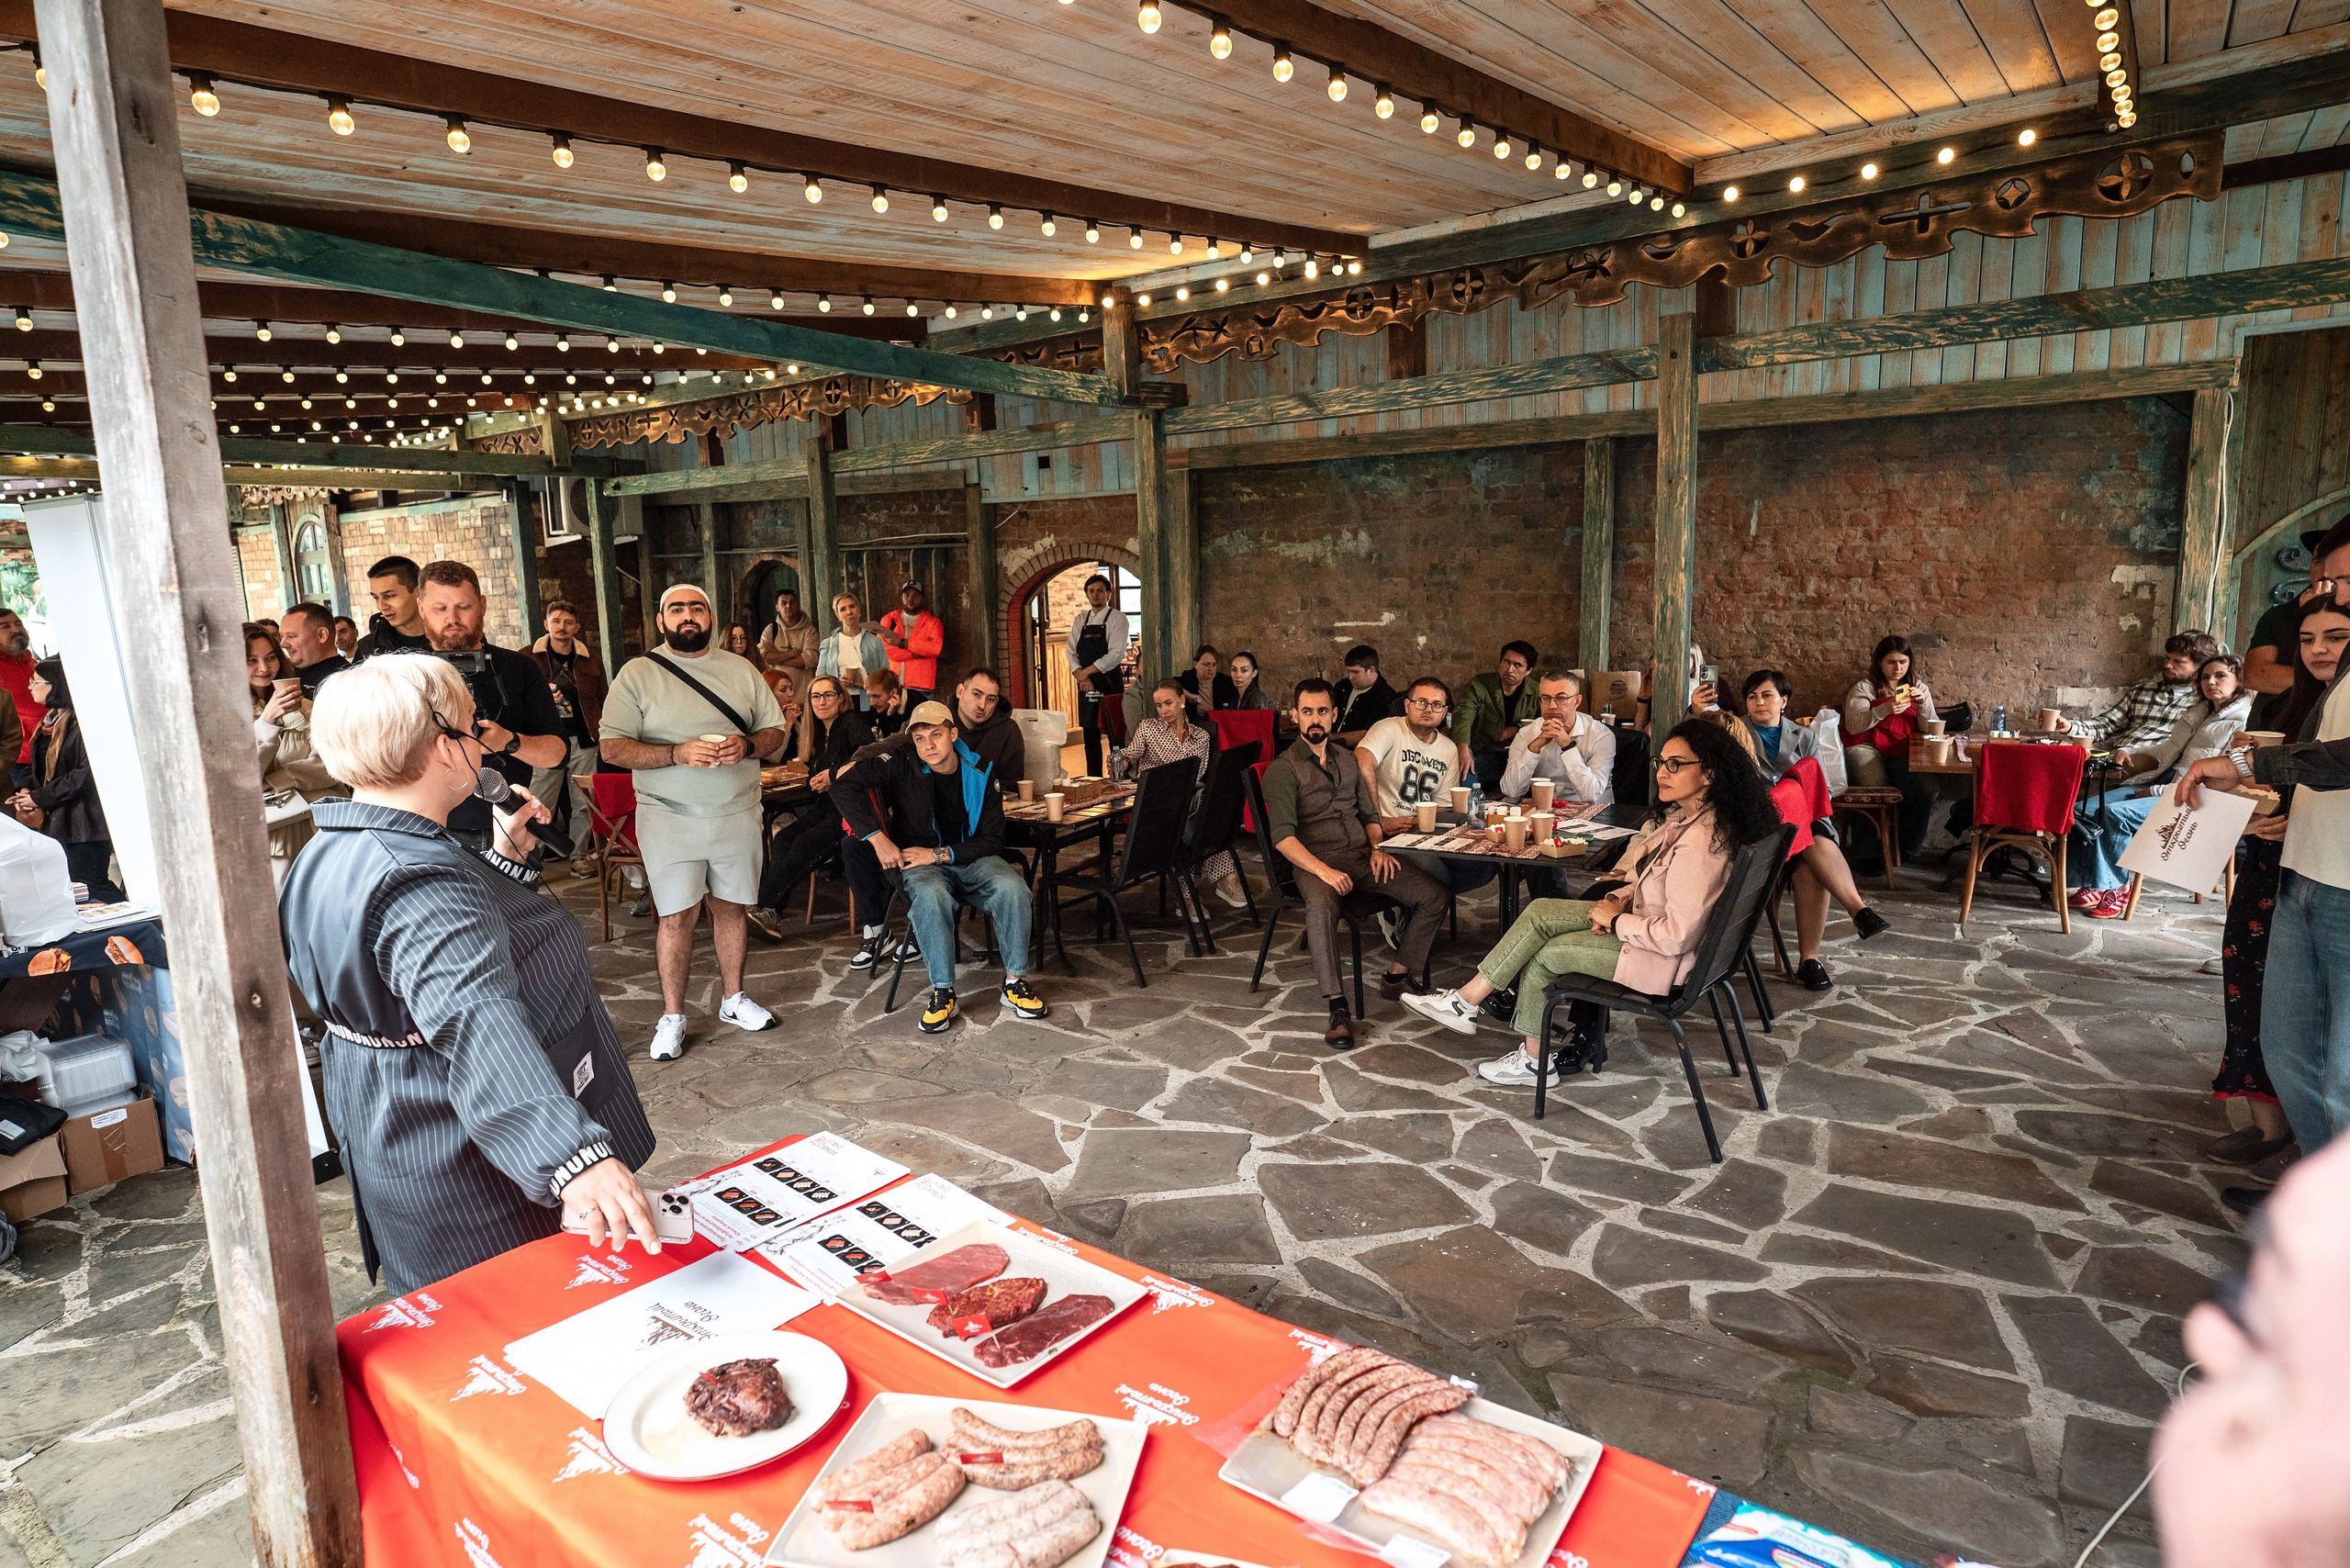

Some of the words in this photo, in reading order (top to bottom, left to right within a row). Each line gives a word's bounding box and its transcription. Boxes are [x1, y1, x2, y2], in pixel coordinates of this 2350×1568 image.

[1398, 764, 1439, 804] 86
[2177, 822, 2198, 850] Огонь
[576, 1254, 630, 1284] Открытый
[606, 1254, 633, 1271] Огонь
[416, 1293, 443, 1313] Огонь
[1139, 1275, 1215, 1307] Открытый
[392, 1296, 436, 1328] Открытый
[645, 1302, 719, 1341] Открытый
[684, 1301, 720, 1323] Огонь
[468, 1354, 528, 1395] Открытый
[1113, 1383, 1200, 1426] Открытый
[1148, 1382, 1191, 1406] Огонь
[729, 1511, 769, 1545] Огонь
[1115, 1525, 1164, 1560] Огонь
